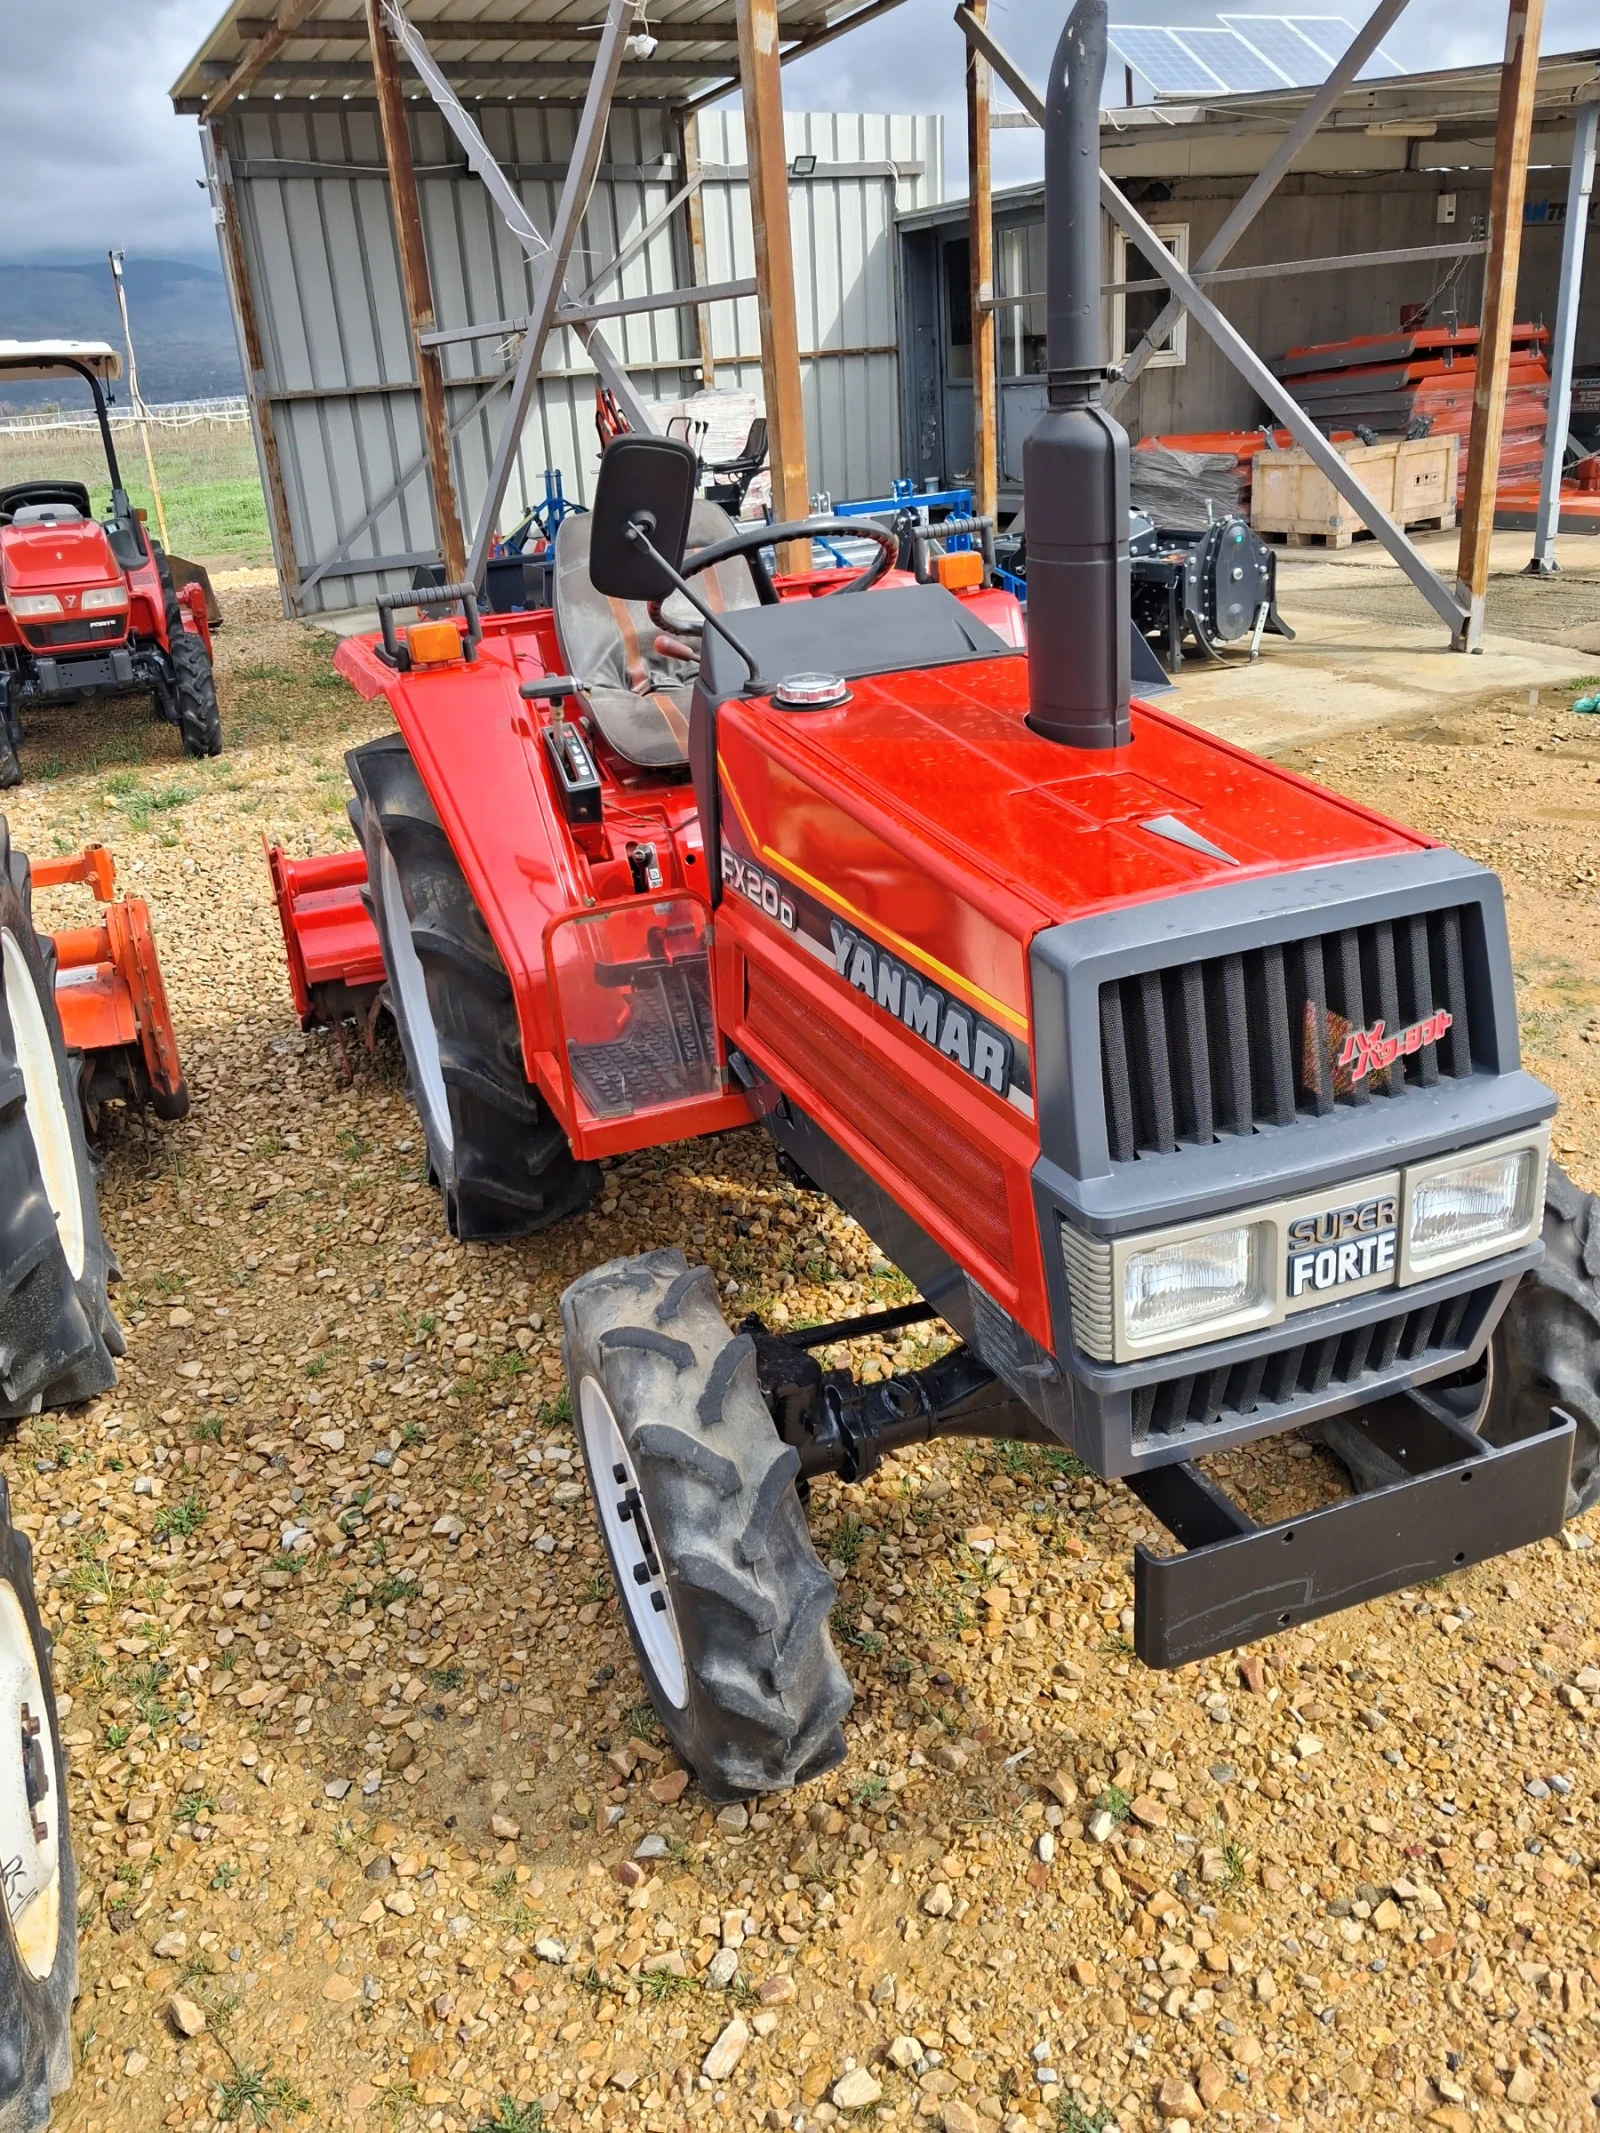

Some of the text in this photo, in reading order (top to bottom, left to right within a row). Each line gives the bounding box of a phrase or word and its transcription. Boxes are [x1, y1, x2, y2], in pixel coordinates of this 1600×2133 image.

[90, 620, 116, 628] FORTE
[830, 920, 1011, 1096] YANMAR
[1352, 1009, 1452, 1082] パワーシフト
[1290, 1195, 1397, 1250] SUPER
[1290, 1231, 1396, 1296] FORTE
